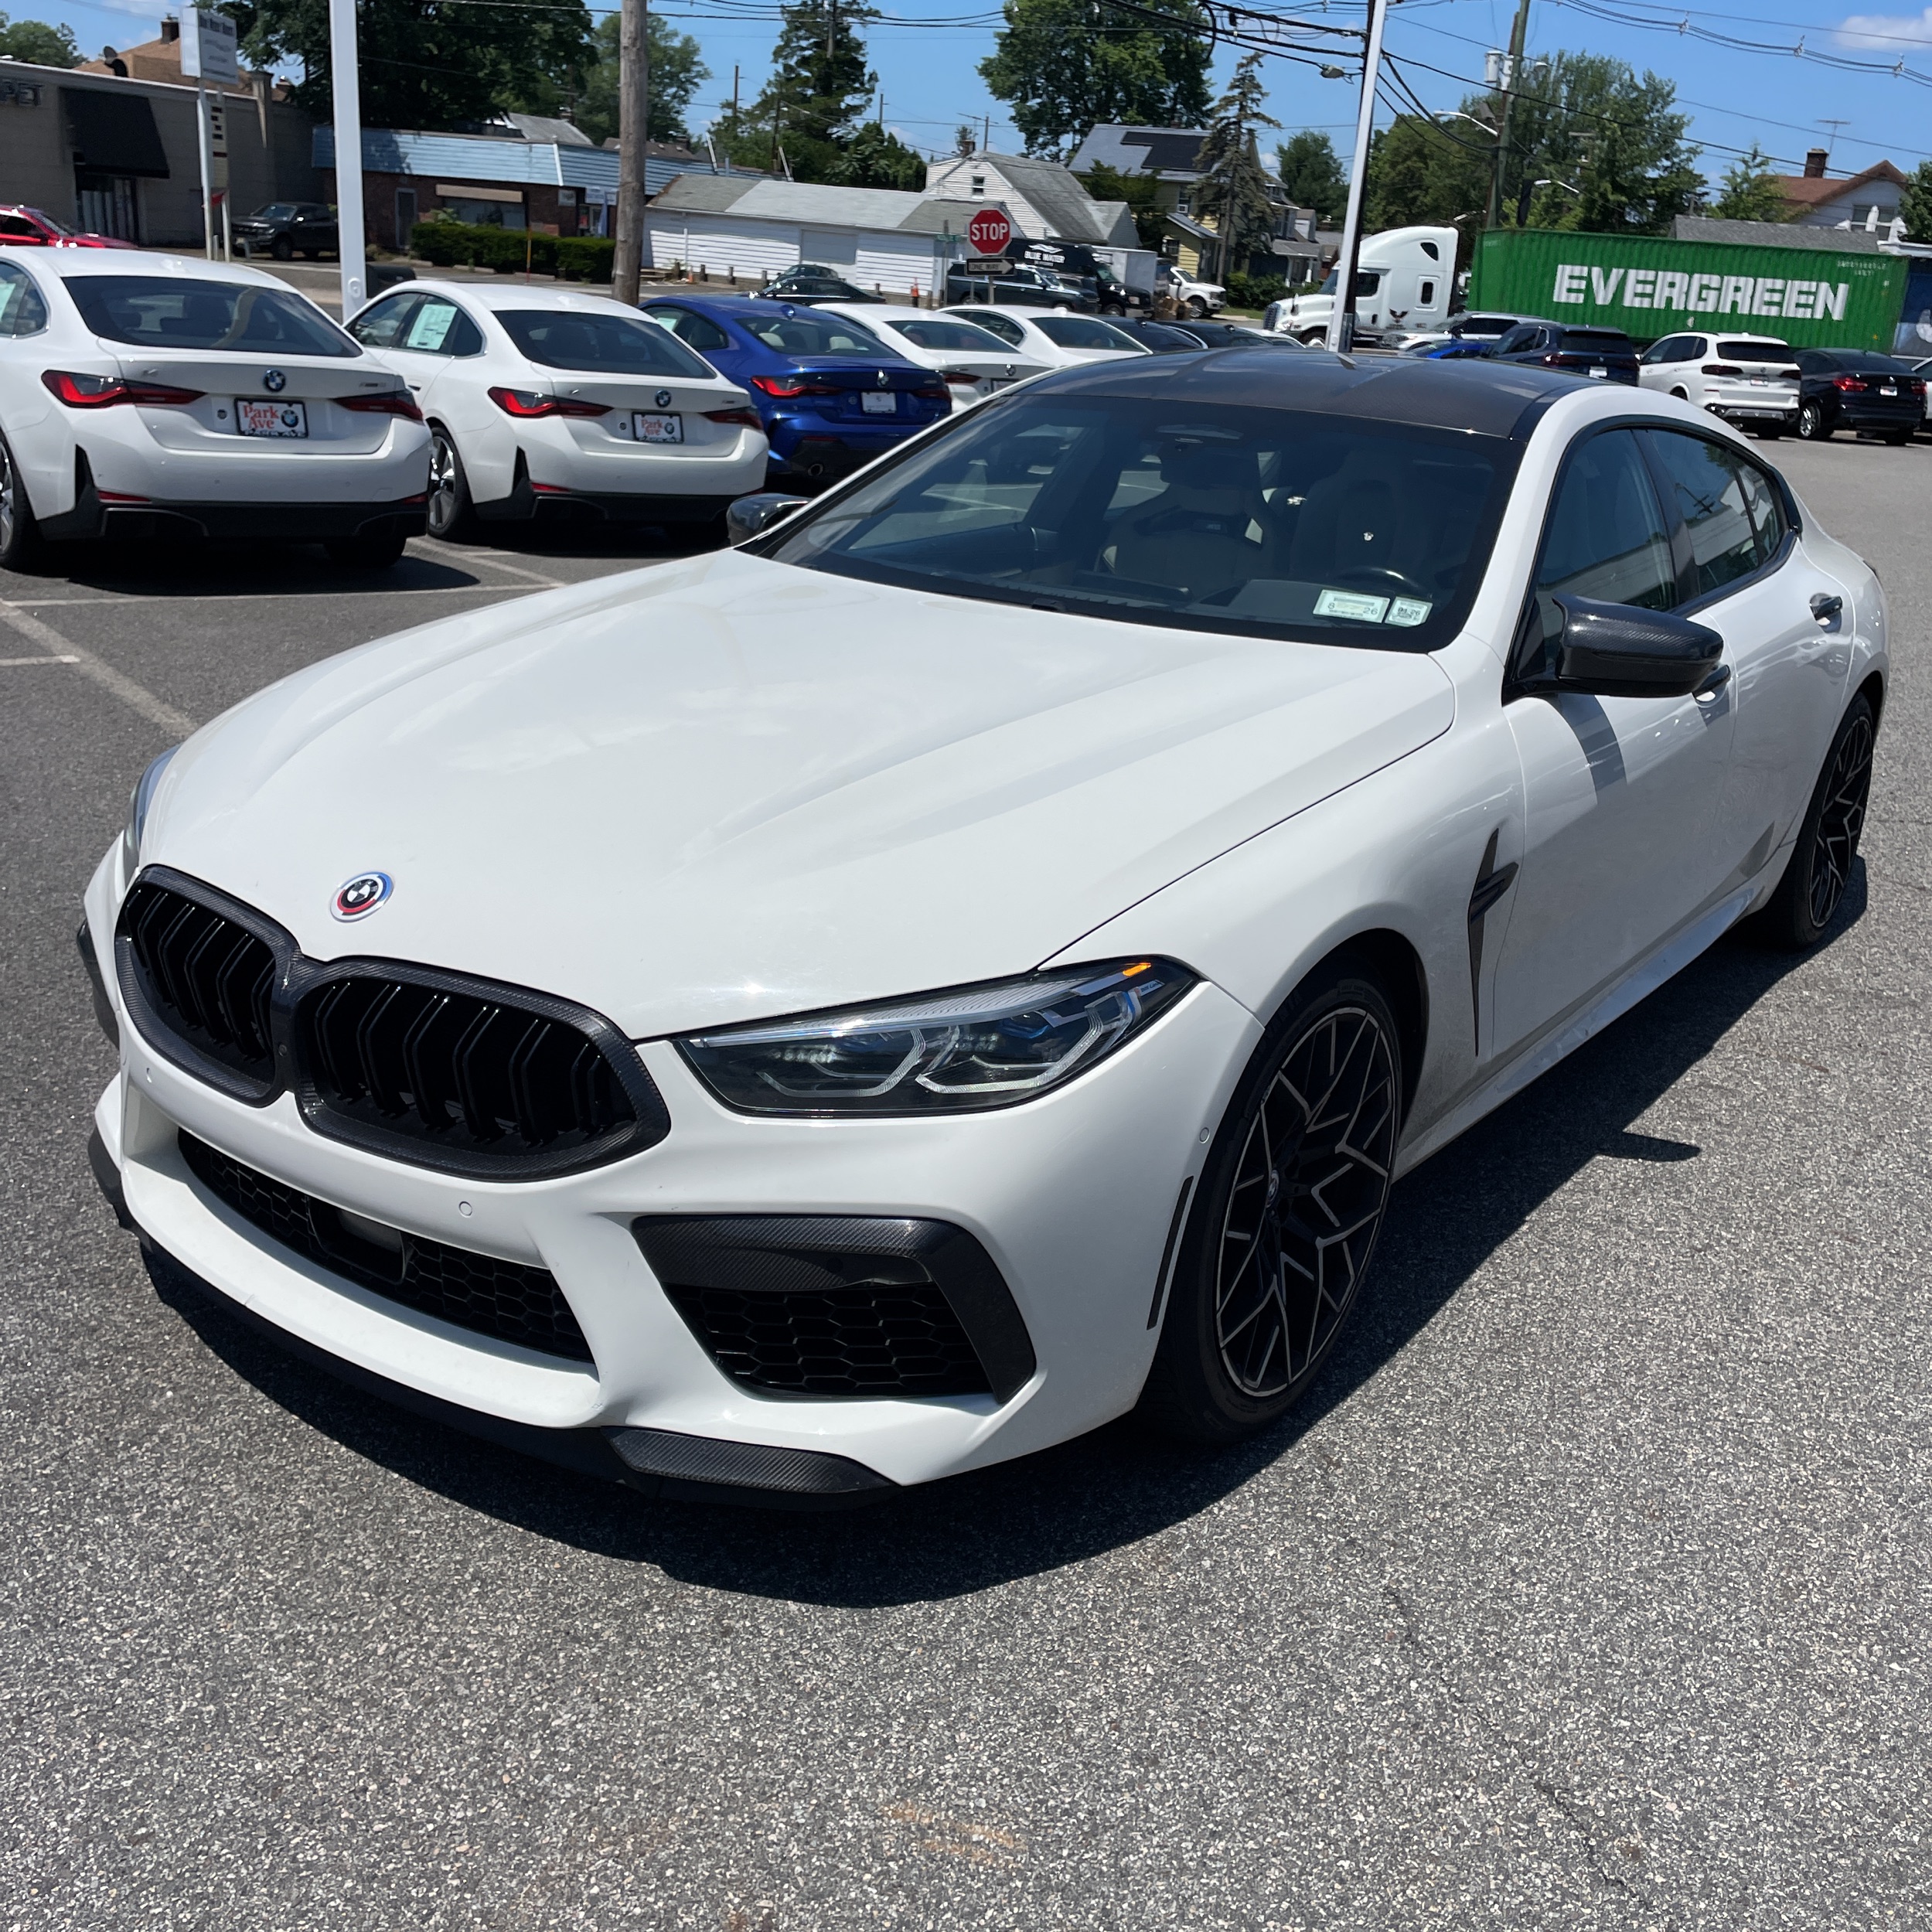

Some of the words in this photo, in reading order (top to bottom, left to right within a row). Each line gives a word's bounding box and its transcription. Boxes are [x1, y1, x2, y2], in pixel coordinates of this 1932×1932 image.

[971, 223, 1008, 241] STOP
[1552, 264, 1849, 321] EVERGREEN
[243, 404, 279, 419] Park
[248, 416, 274, 429] Ave
[641, 419, 663, 429] Park
[1362, 607, 1378, 615] 26
